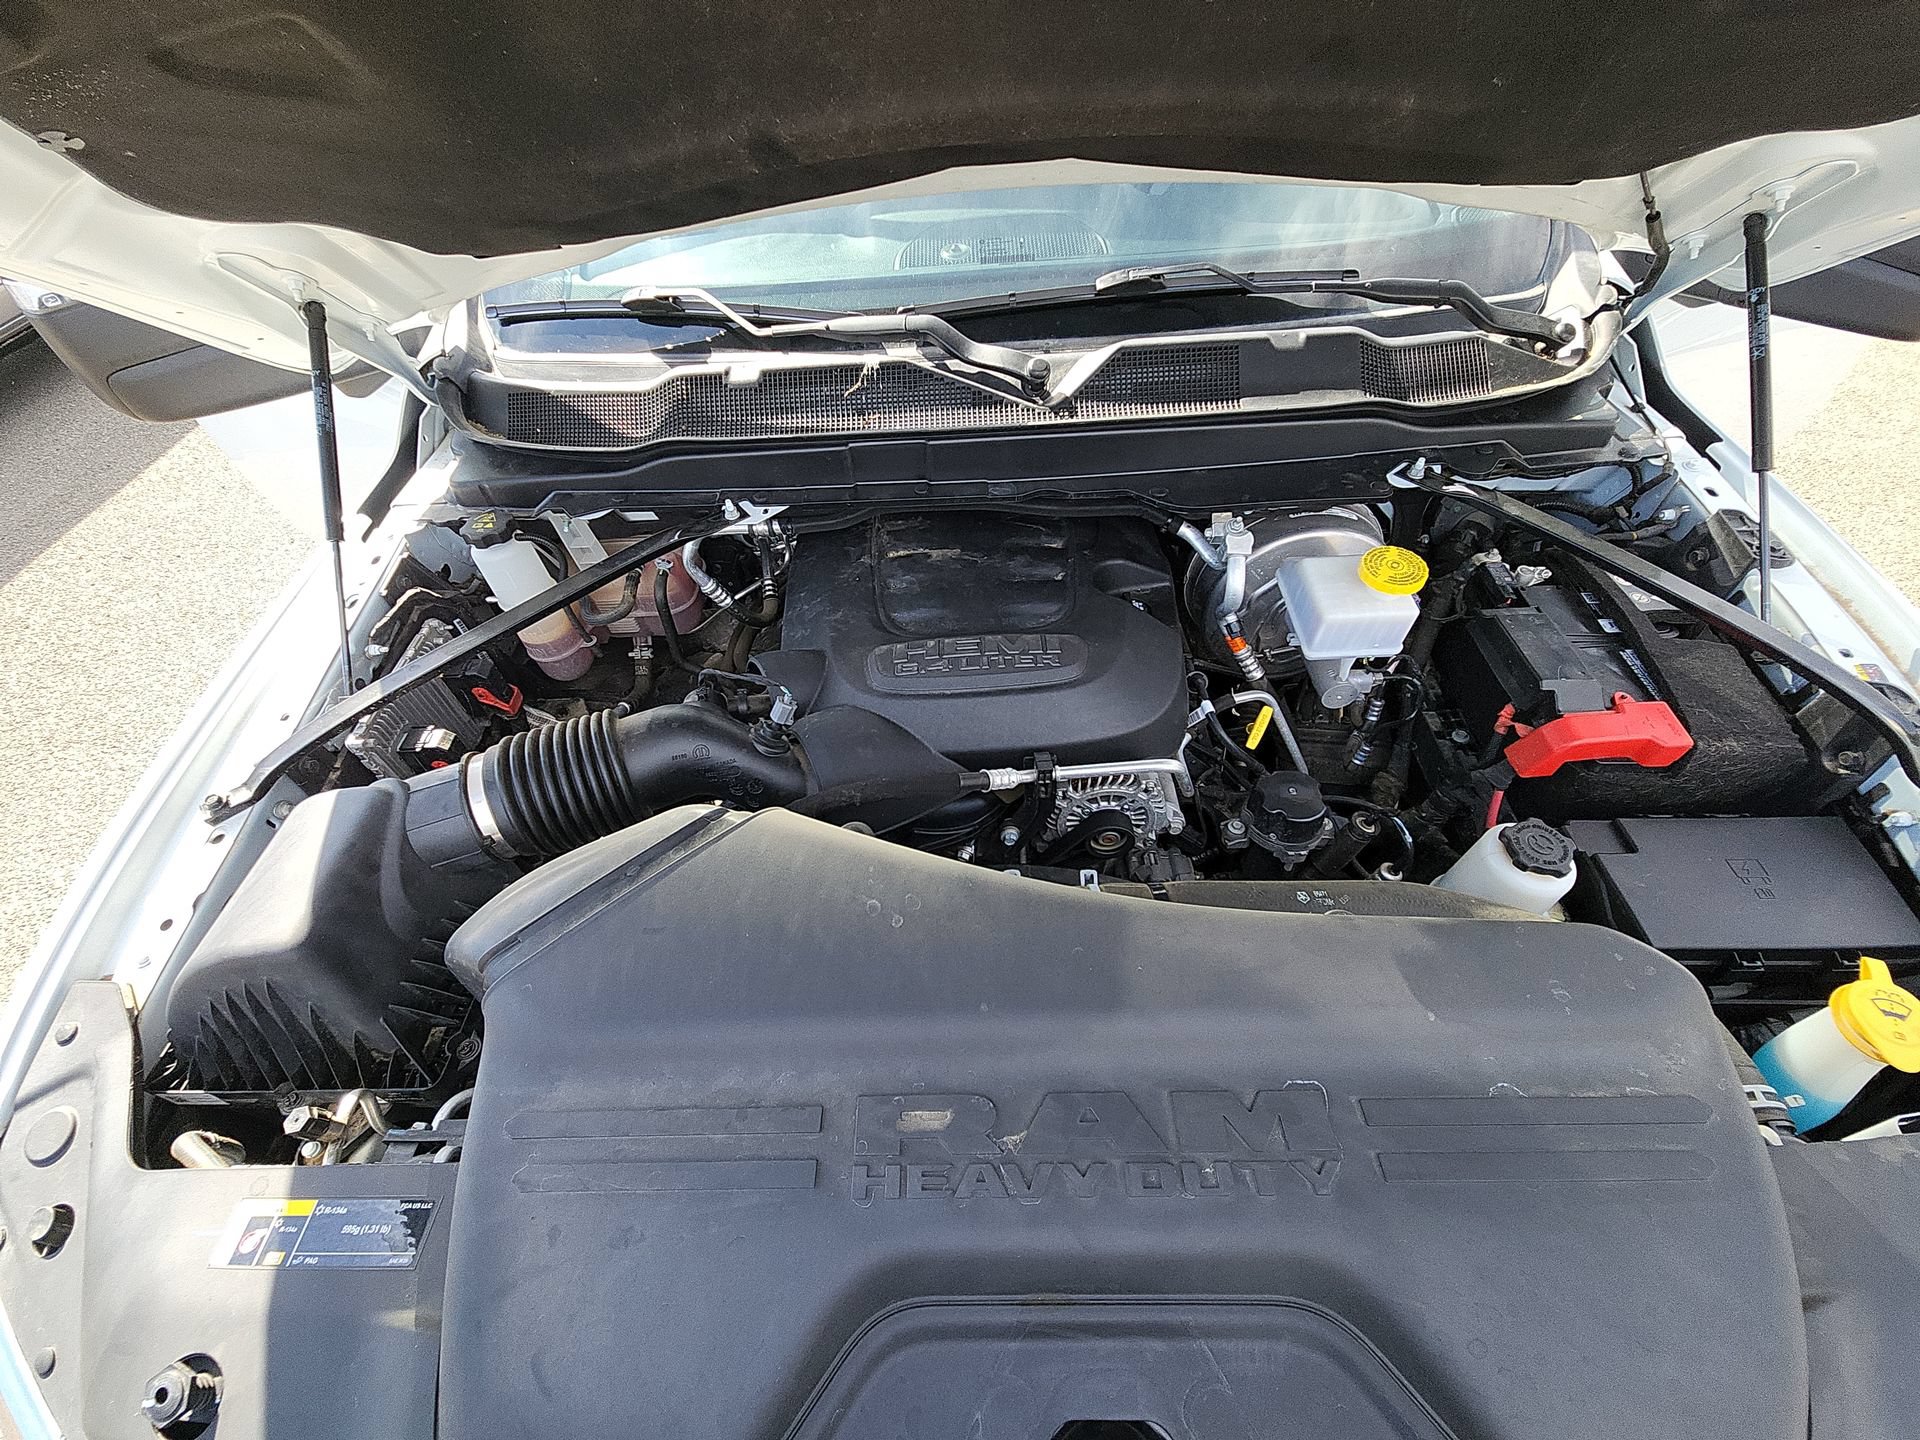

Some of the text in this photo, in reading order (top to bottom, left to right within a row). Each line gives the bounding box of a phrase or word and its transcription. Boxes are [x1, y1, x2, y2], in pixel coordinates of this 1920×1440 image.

[892, 634, 1062, 664] HEMI
[894, 654, 1062, 676] 6.4 LITER
[855, 1089, 1343, 1157] RAM
[851, 1160, 1339, 1200] HEAVY DUTY
[379, 1223, 392, 1236] lb)
